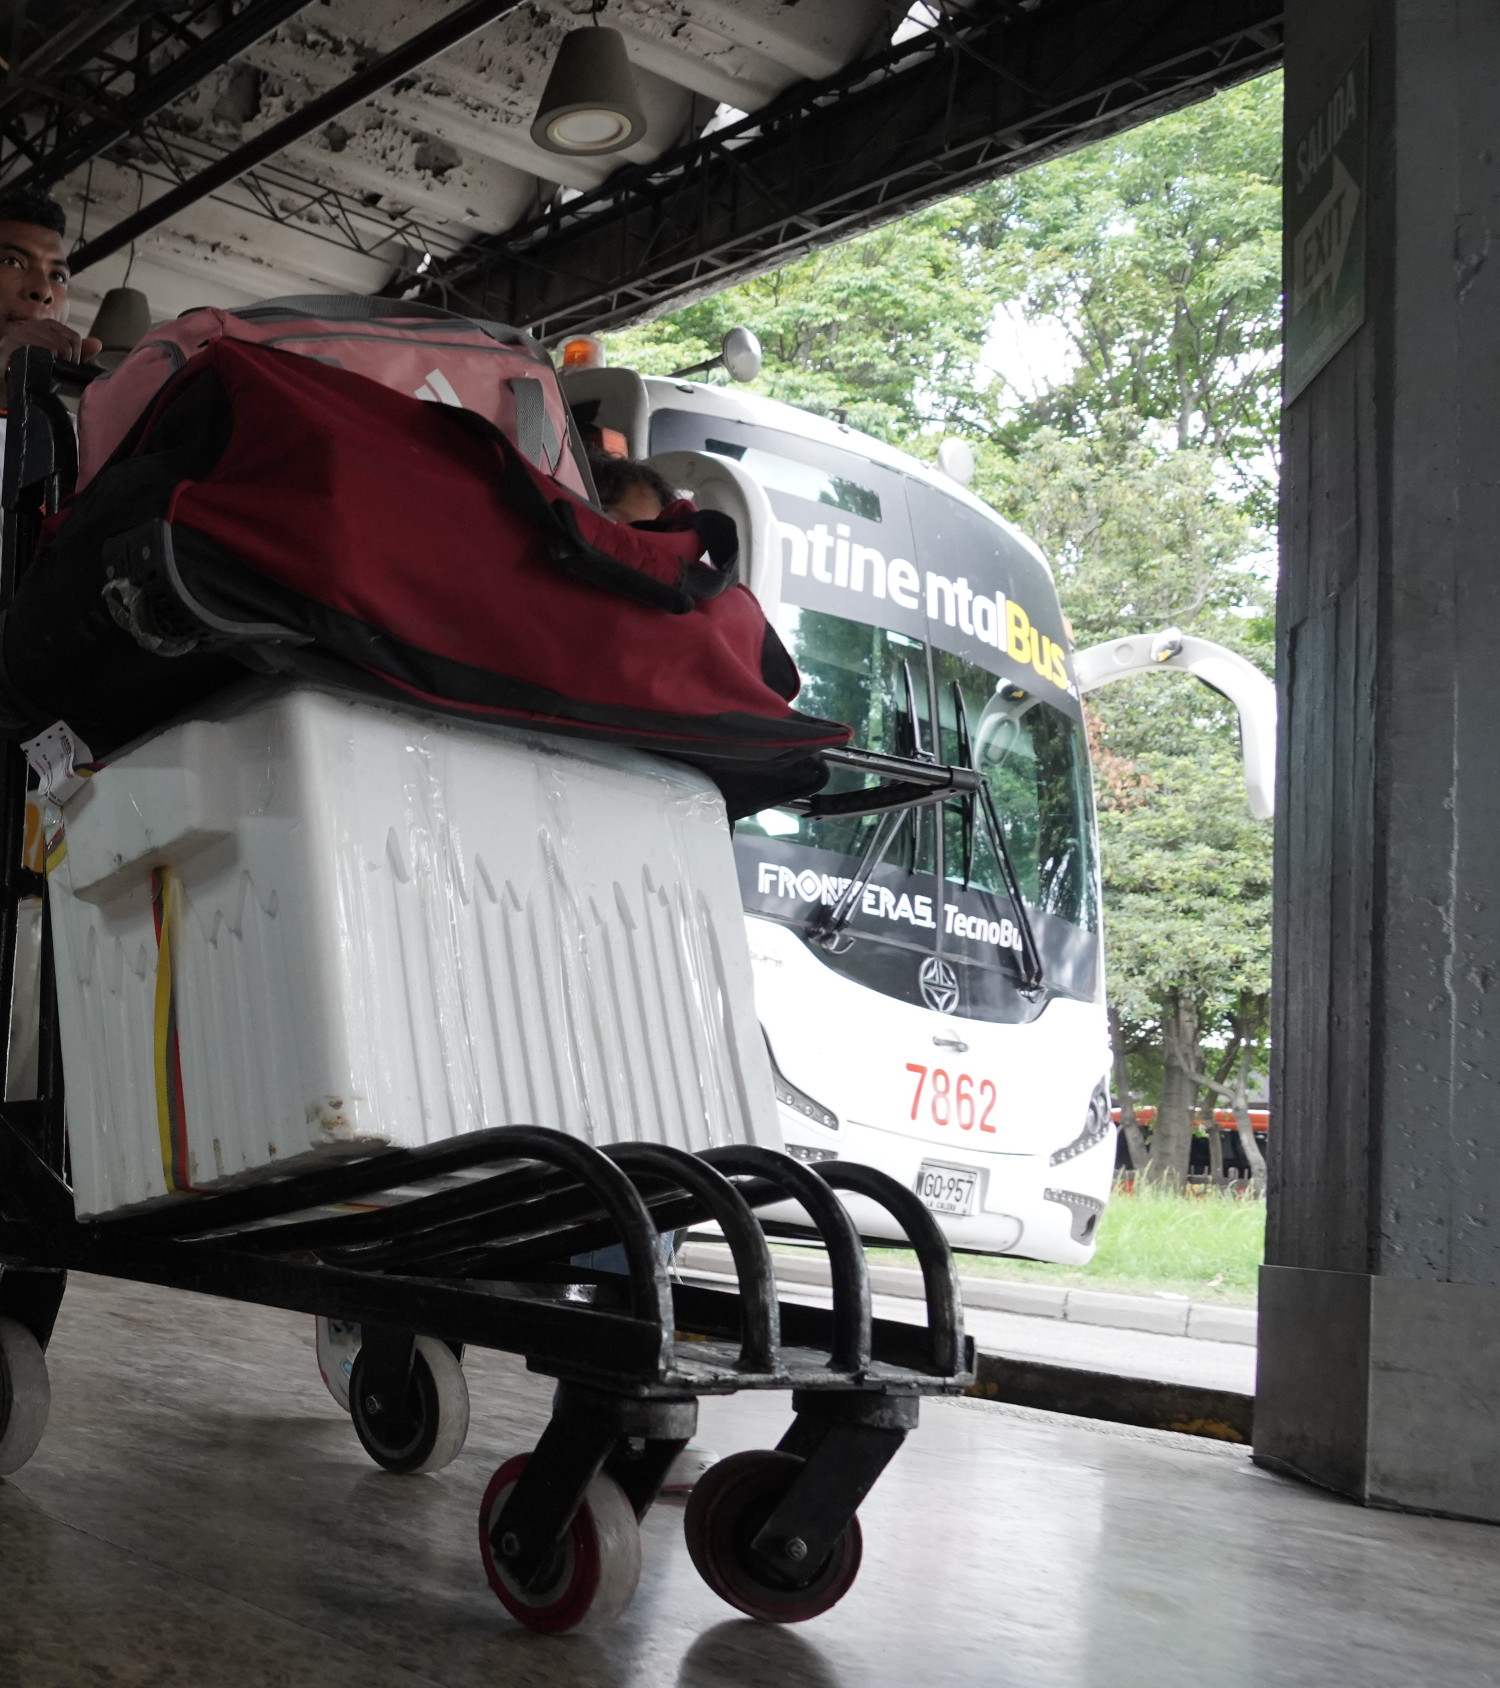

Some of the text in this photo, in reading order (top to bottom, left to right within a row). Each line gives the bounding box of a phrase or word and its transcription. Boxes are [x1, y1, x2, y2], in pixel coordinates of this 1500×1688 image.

[1296, 70, 1357, 194] SALIDA
[1304, 190, 1346, 288] EXIT
[778, 521, 1069, 691] ntinentalBus
[944, 903, 1023, 952] TecnoBu
[905, 1062, 997, 1134] 7862
